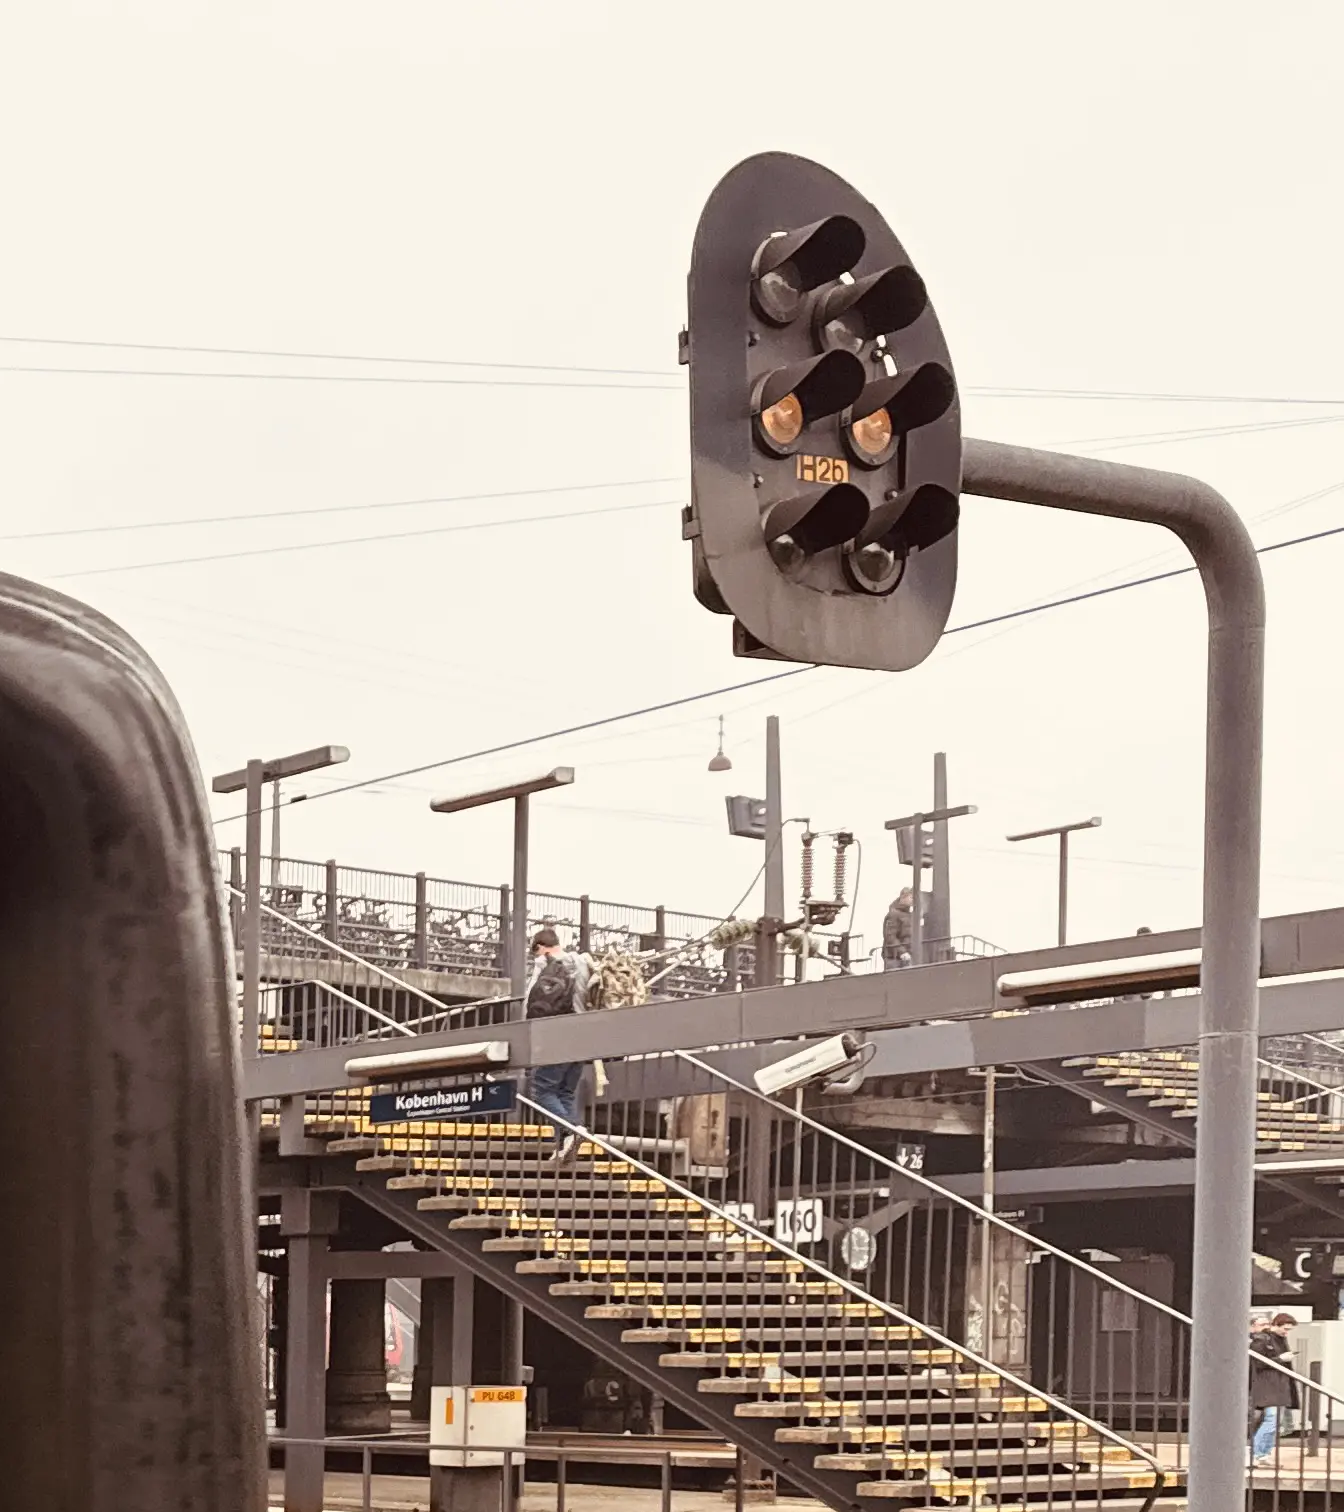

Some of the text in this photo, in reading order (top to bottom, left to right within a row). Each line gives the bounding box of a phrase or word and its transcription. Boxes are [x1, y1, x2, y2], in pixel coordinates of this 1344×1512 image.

[800, 455, 844, 483] H2b
[395, 1086, 483, 1110] København H
[910, 1153, 924, 1169] 26
[780, 1208, 817, 1235] 160
